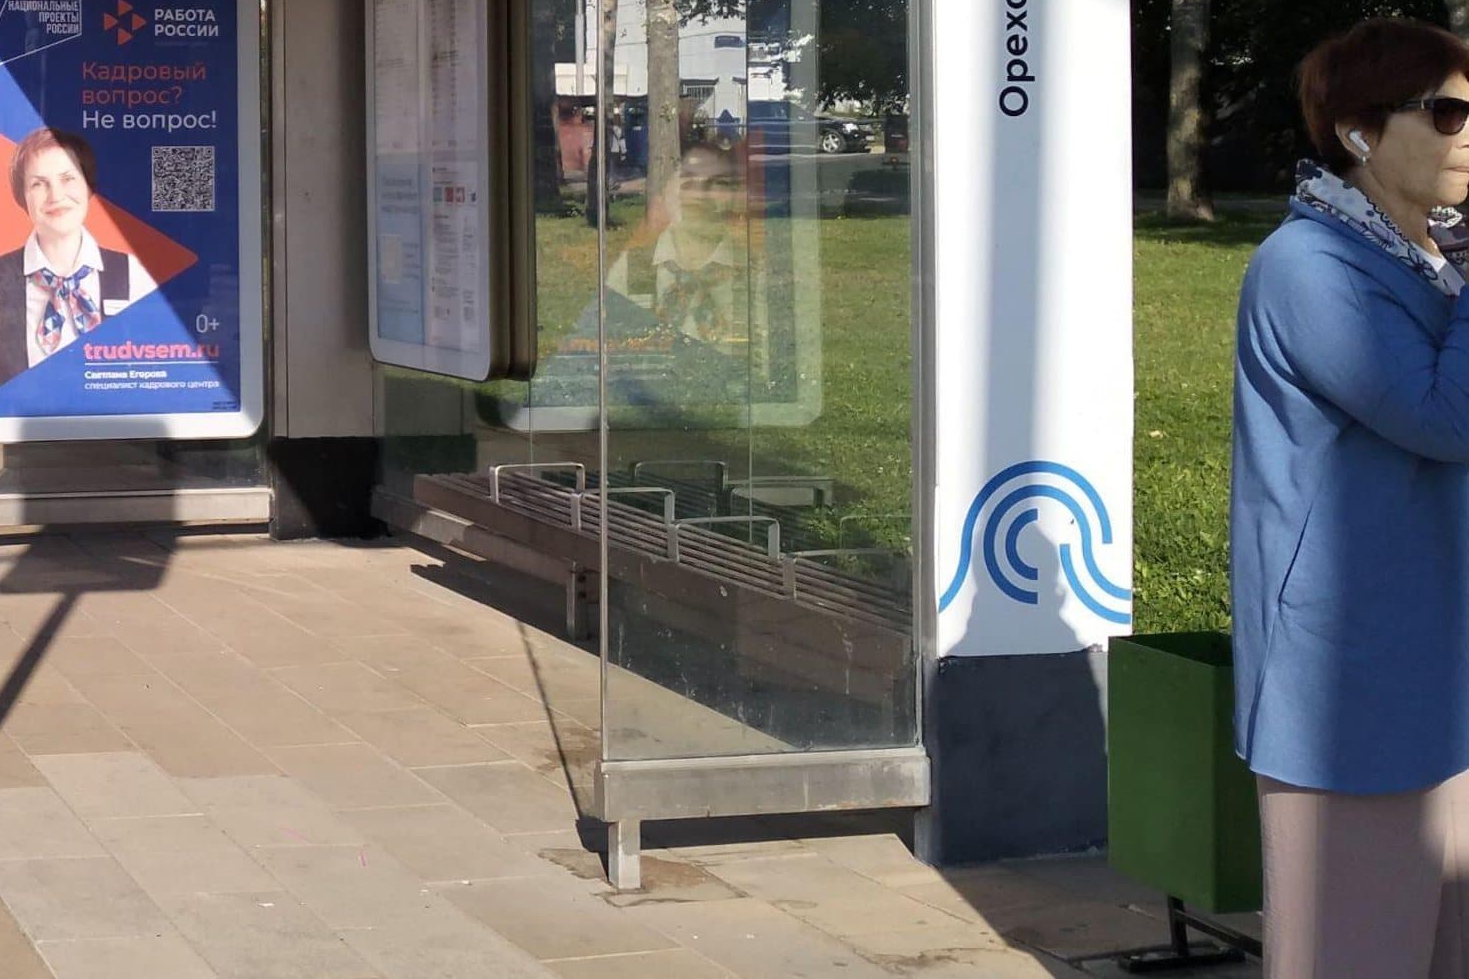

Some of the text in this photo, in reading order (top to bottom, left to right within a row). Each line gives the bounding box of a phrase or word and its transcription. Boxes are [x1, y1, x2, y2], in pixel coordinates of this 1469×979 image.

[7, 0, 79, 12] НАЦИОНАЛЬНЫЕ
[38, 11, 79, 23] ПРОЕКТЫ
[154, 8, 216, 22] РАБОТА
[46, 23, 79, 34] РОССИИ
[154, 24, 219, 37] РОССИИ
[82, 61, 206, 84] Кадровый
[82, 86, 183, 108] вопрос?
[82, 110, 217, 133] Не вопрос!
[196, 314, 220, 333] 0+
[83, 341, 220, 360] trudvsem.ru
